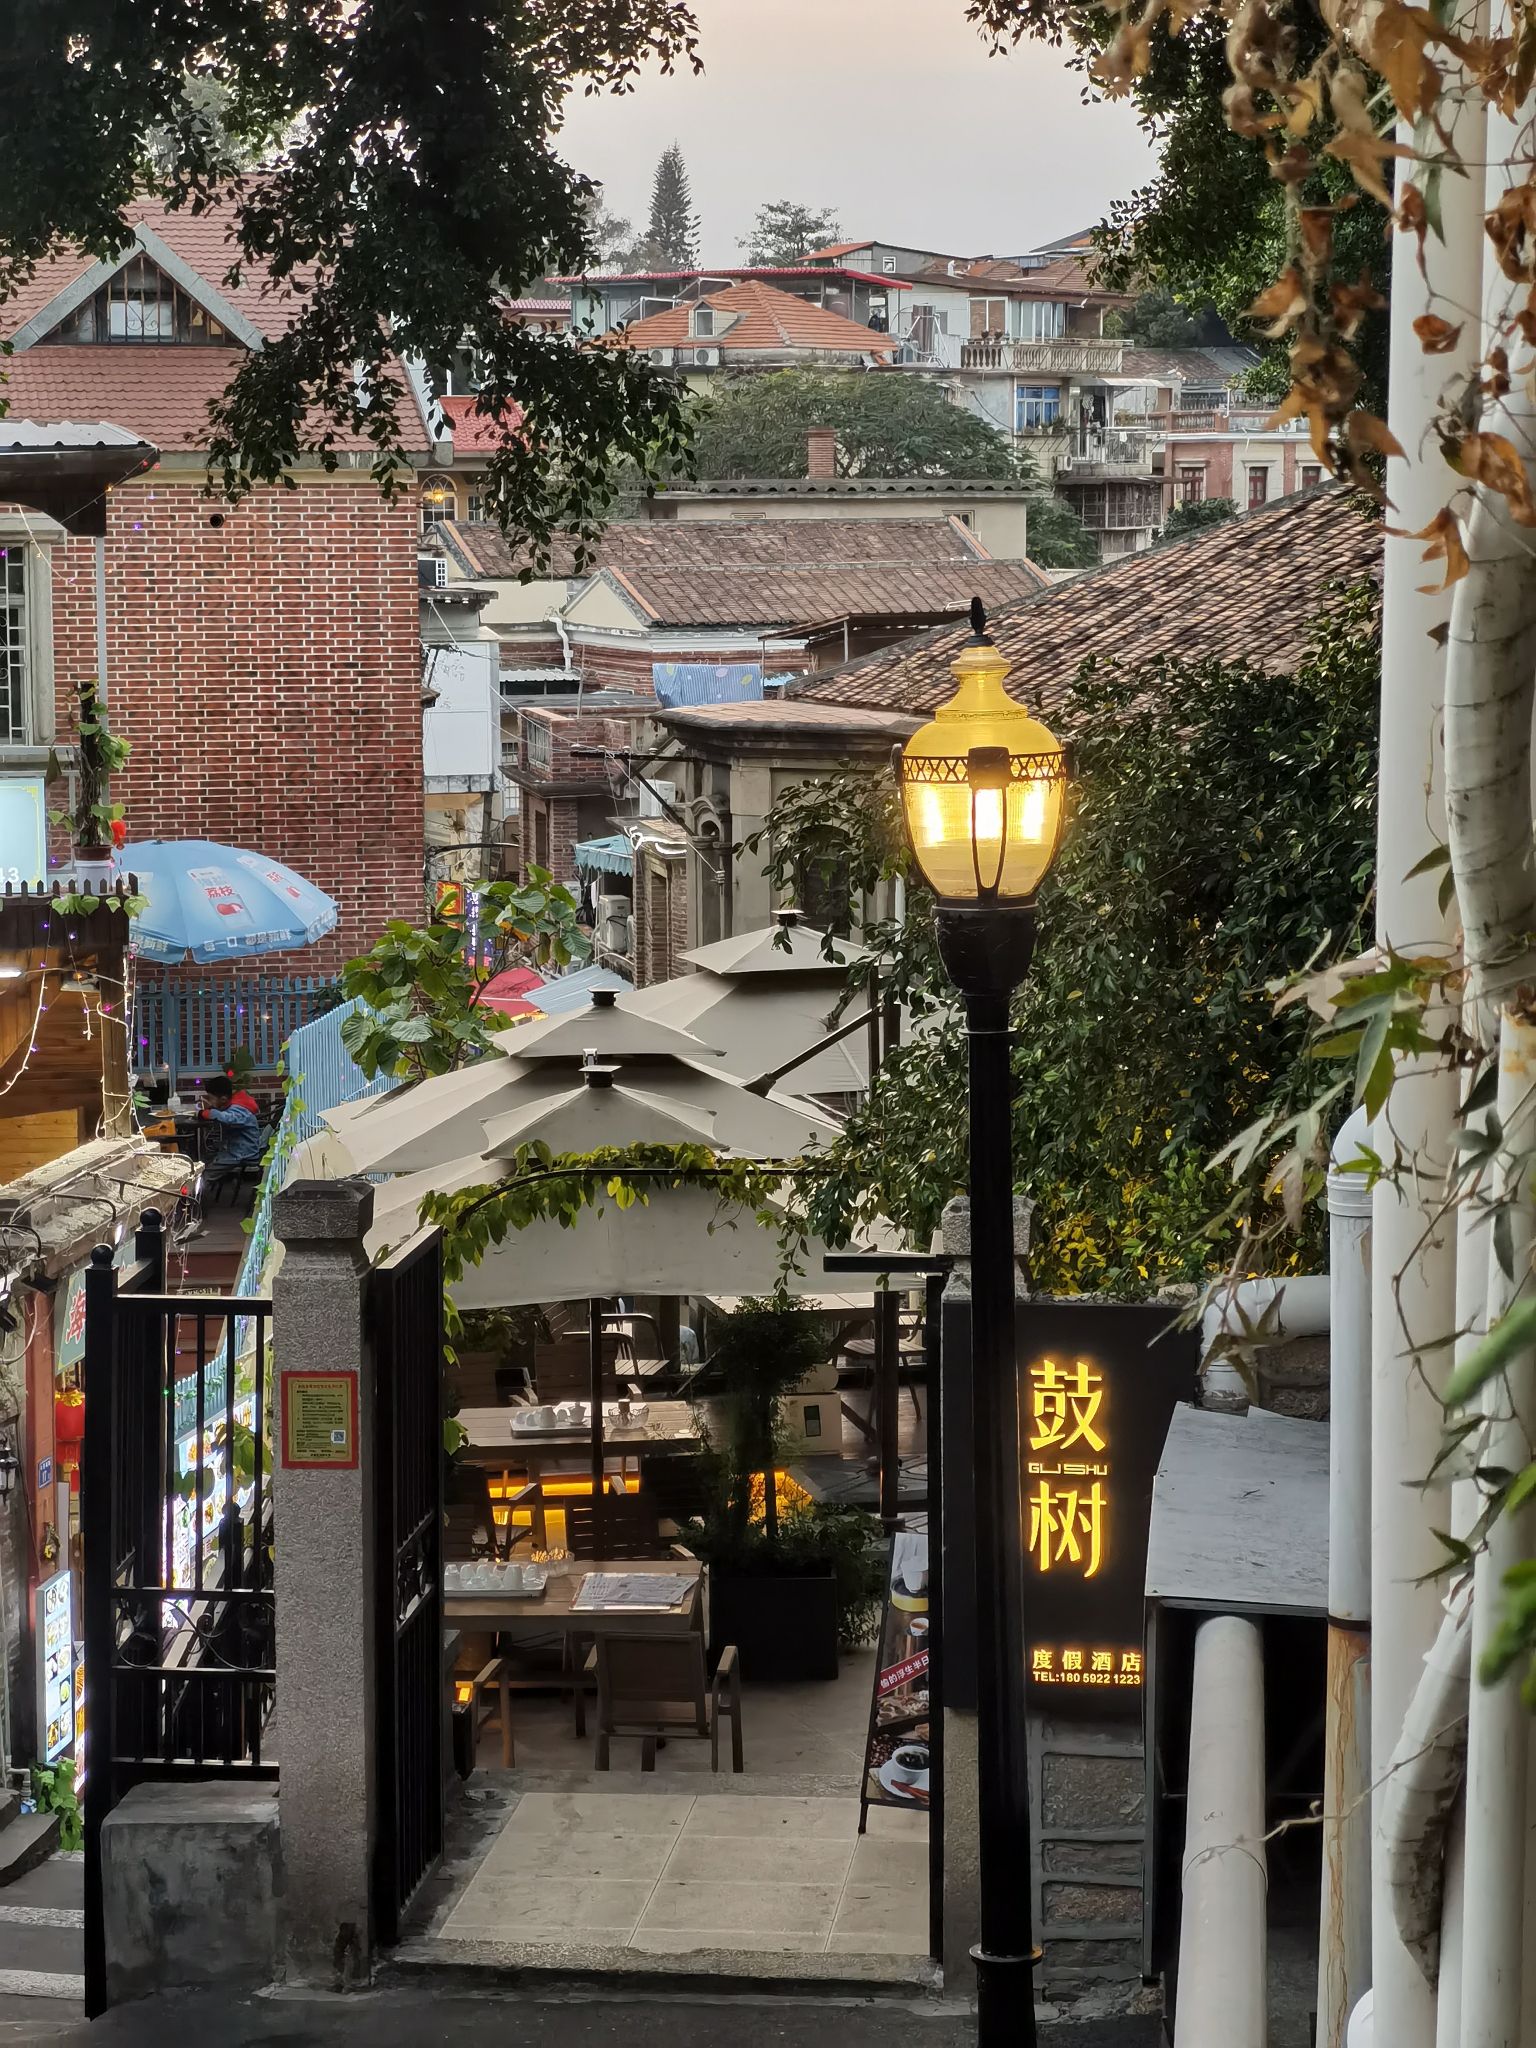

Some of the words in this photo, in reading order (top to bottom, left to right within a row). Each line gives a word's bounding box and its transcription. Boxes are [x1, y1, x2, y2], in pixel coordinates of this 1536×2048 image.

[1030, 1360, 1106, 1452] 鼓
[1028, 1462, 1108, 1476] GUSHU
[1029, 1480, 1107, 1578] 树
[1032, 1649, 1141, 1672] 度假酒店
[1032, 1671, 1080, 1683] TEL:180
[1082, 1673, 1111, 1684] 5922
[1113, 1674, 1141, 1685] 1223
